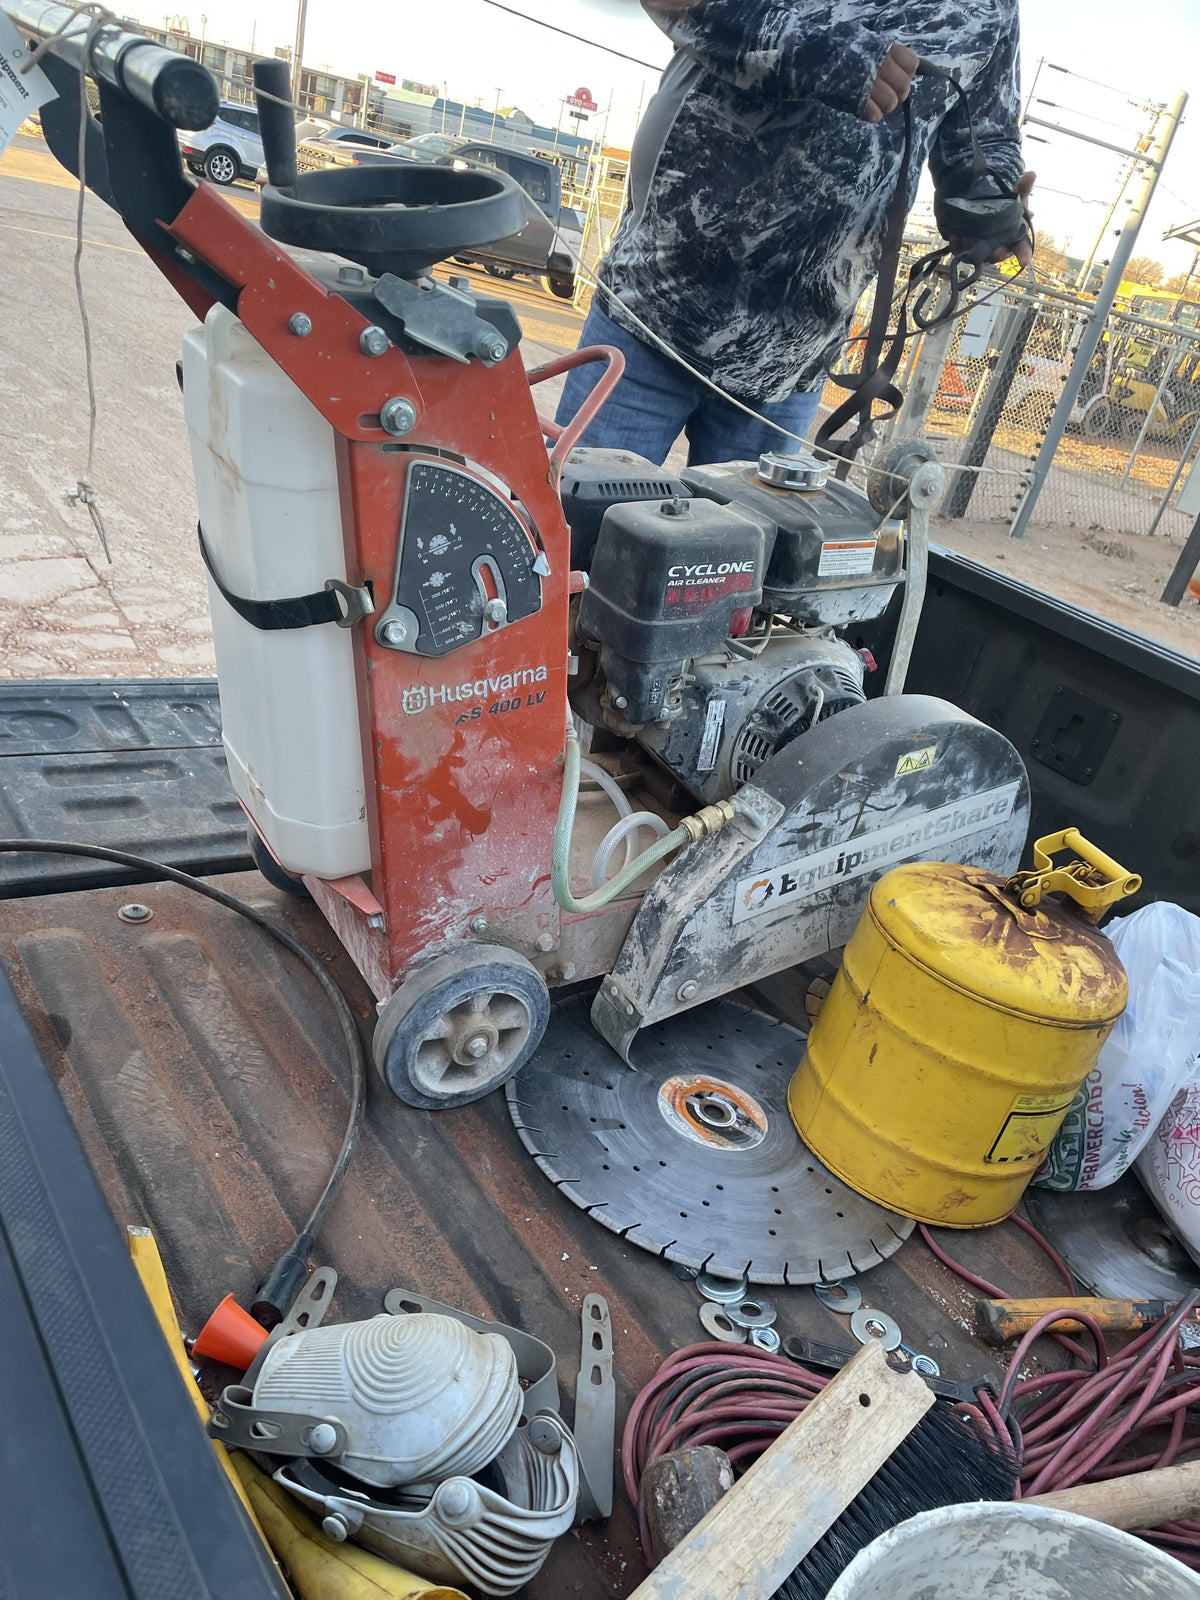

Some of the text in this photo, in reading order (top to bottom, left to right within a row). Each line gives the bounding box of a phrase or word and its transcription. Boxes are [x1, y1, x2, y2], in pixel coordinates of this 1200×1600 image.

[667, 576, 726, 587] AIR CLEANER
[668, 560, 754, 577] CYCLONE
[429, 665, 548, 706] Husqvarna
[454, 690, 547, 726] FS 400 LV
[778, 797, 1010, 897] EquipmentShare
[1079, 1068, 1104, 1190] PERMERCADO
